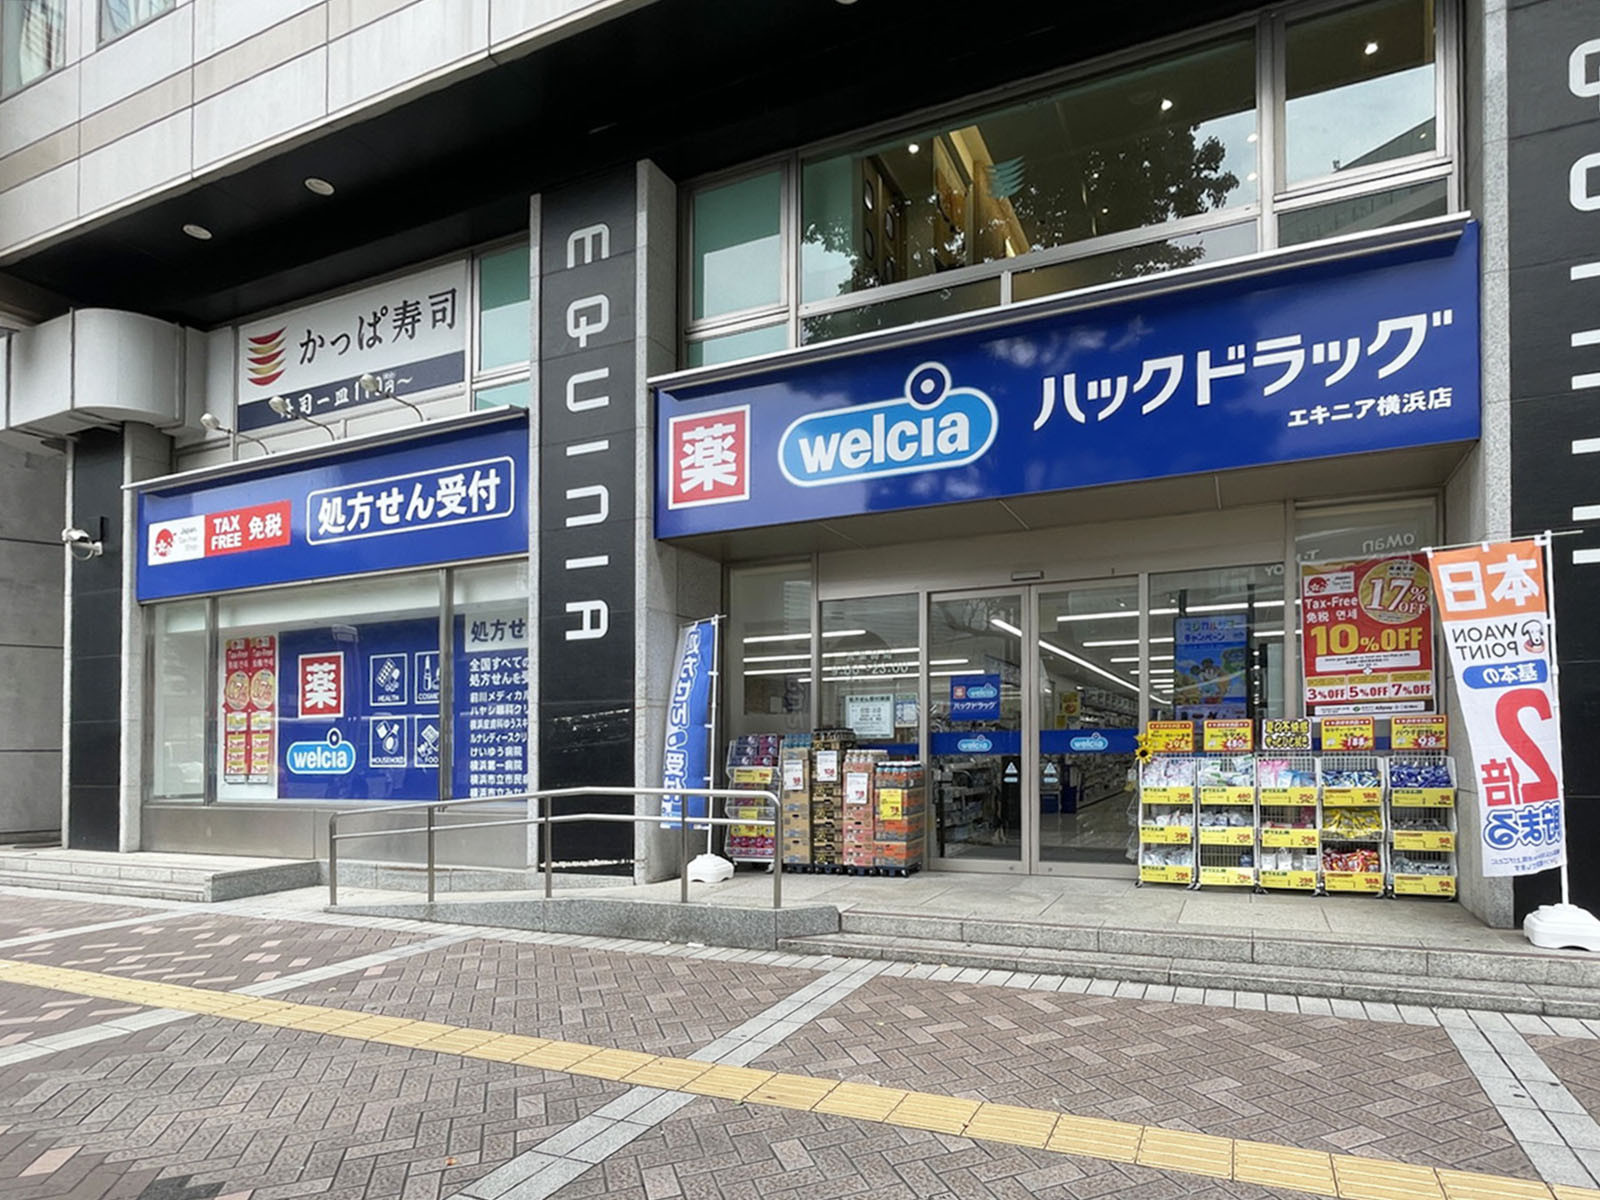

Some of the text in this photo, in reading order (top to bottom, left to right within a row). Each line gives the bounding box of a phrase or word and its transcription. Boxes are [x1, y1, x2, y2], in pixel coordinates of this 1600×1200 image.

[300, 287, 457, 365] かっぱ寿司
[1033, 309, 1453, 431] ハックドラッグ
[1287, 386, 1453, 428] エキニア横浜店
[798, 411, 970, 474] welcia
[680, 422, 738, 493] 薬
[318, 468, 500, 536] 処方せん受付
[213, 515, 240, 534] TAX
[248, 512, 283, 540] 免税
[211, 532, 242, 551] FREE
[1304, 596, 1358, 610] Tax-Free
[1366, 578, 1427, 610] 17%
[1306, 611, 1329, 624] 免税
[1398, 602, 1427, 615] OFF
[1310, 623, 1423, 655] 10%OFF
[304, 663, 337, 709] 薬
[1307, 688, 1345, 700] 3%OFF
[1349, 686, 1388, 698] 5%OFF
[1391, 683, 1431, 696] 7%OFF
[1418, 736, 1436, 747] 98
[294, 746, 348, 768] welcia
